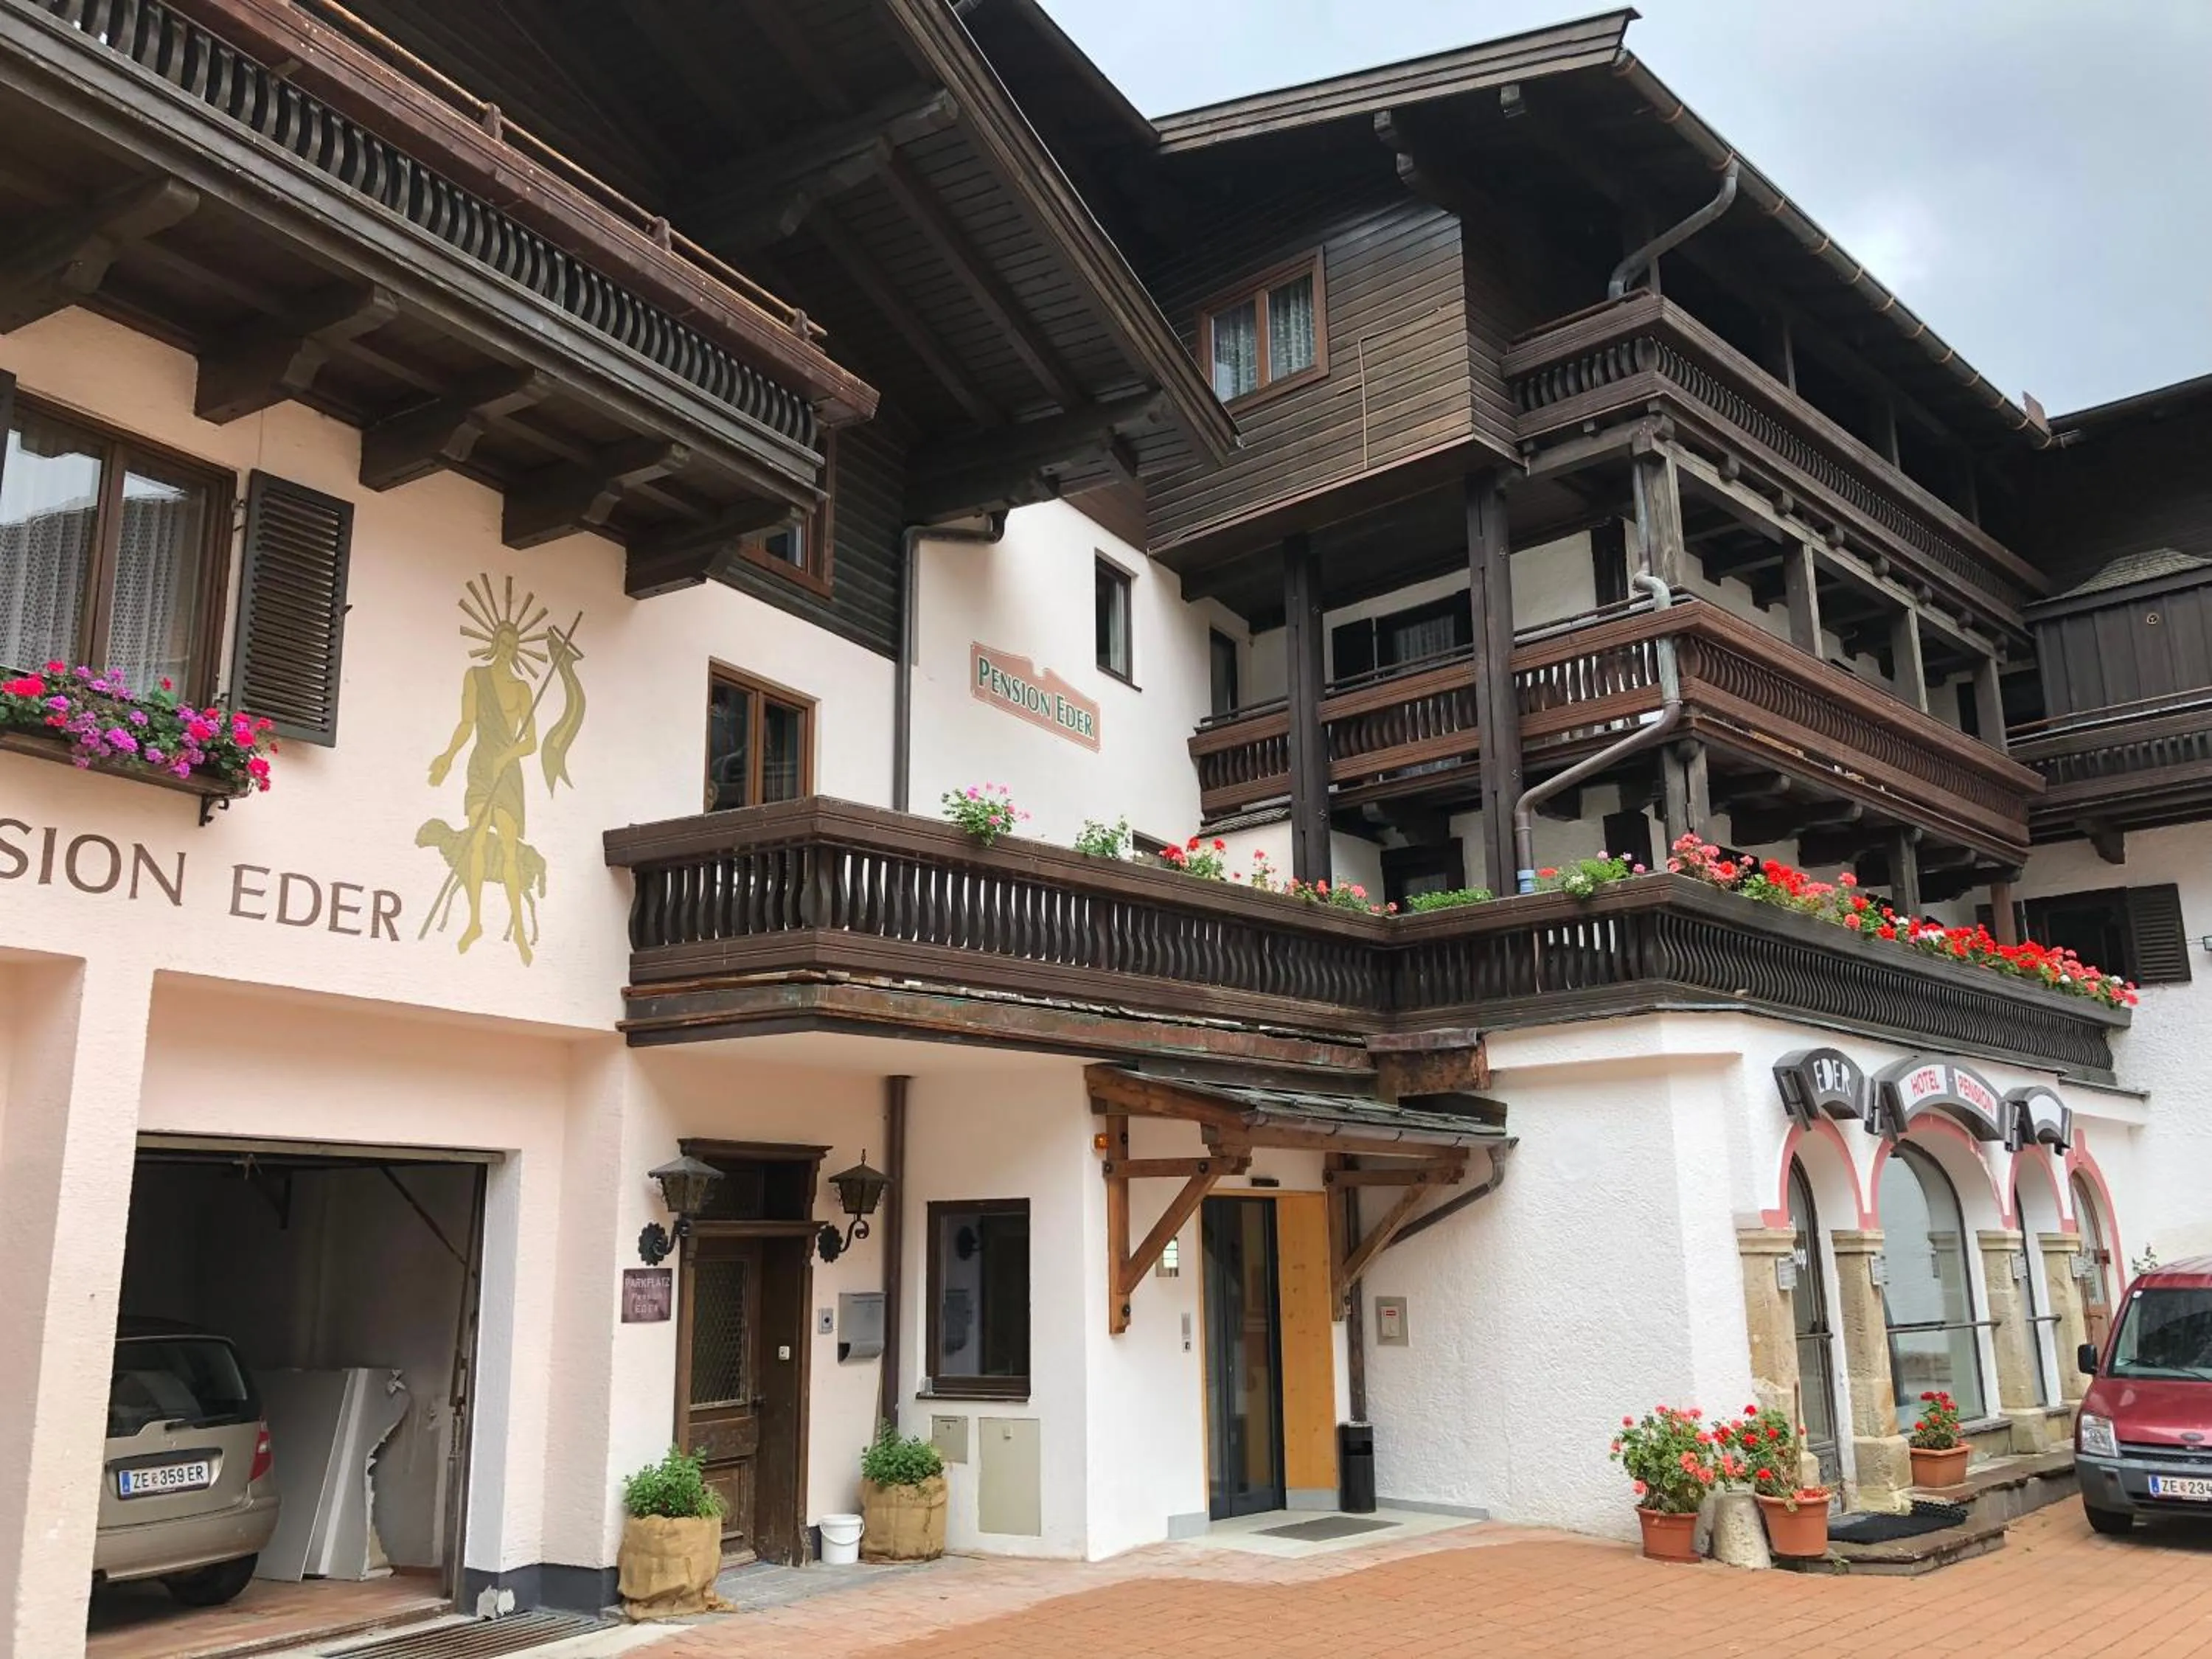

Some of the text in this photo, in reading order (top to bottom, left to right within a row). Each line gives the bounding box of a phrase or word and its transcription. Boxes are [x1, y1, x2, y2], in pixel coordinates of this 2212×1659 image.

[978, 657, 1094, 737] PENSION EDER
[0, 818, 401, 942] SION EDER
[1813, 1058, 1851, 1097] EDER
[1911, 1070, 1994, 1116] HOTEL PENSION
[625, 1276, 670, 1289] PARKPLATZ
[133, 1472, 149, 1489] ZE
[2162, 1480, 2178, 1493] ZE
